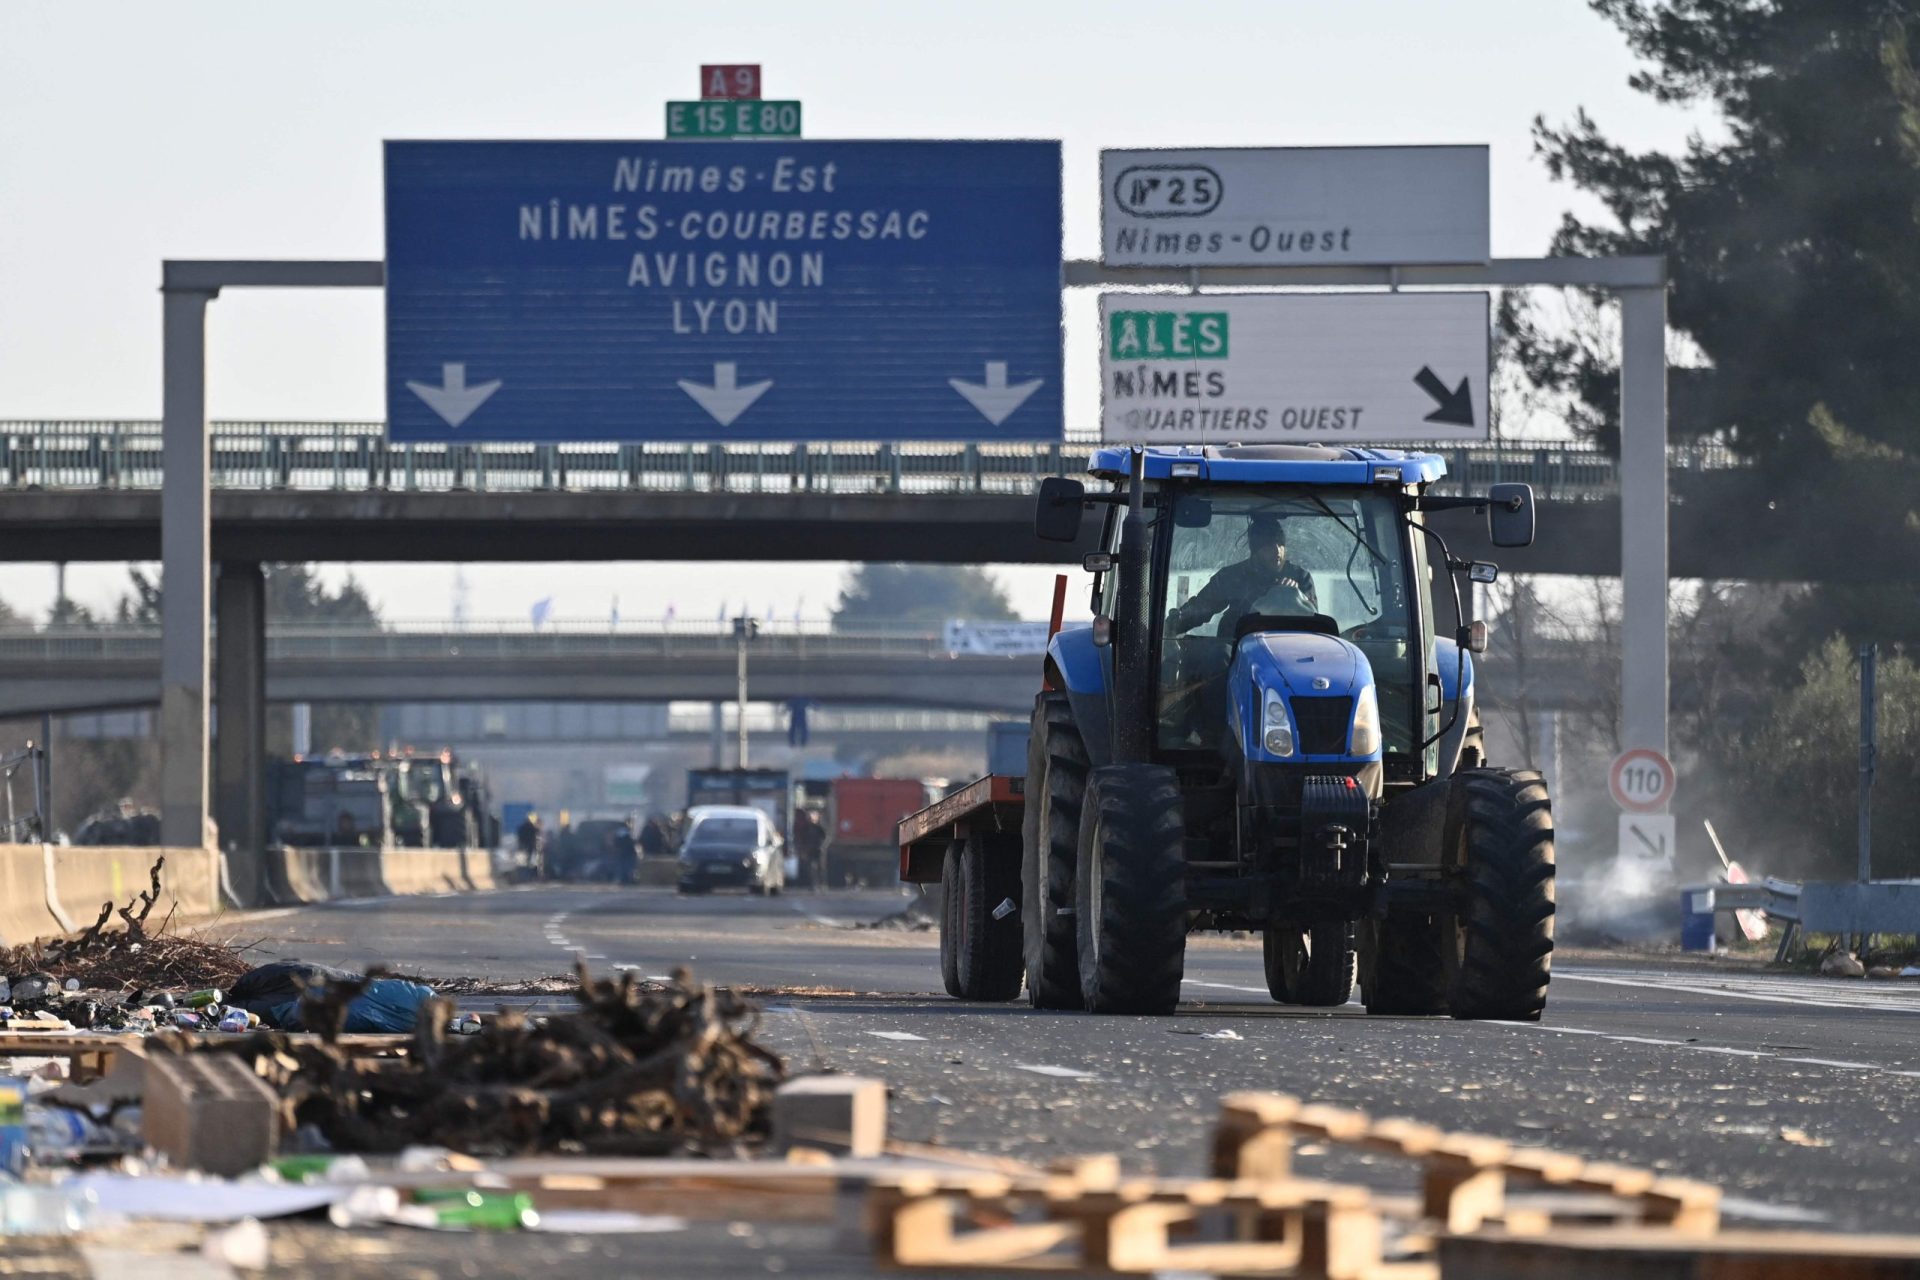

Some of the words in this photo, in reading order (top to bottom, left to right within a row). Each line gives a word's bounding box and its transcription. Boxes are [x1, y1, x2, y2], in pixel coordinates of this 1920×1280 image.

[709, 69, 727, 95] A
[735, 68, 754, 95] 9
[670, 105, 686, 133] E
[694, 105, 726, 133] 15
[736, 105, 753, 133] E
[760, 105, 797, 133] 80
[1167, 177, 1212, 205] 25
[627, 252, 824, 288] AVIGNON
[672, 299, 779, 334] LYON
[1117, 312, 1223, 354] ALÈS
[1280, 407, 1364, 430] OUEST
[1624, 767, 1662, 794] 110
